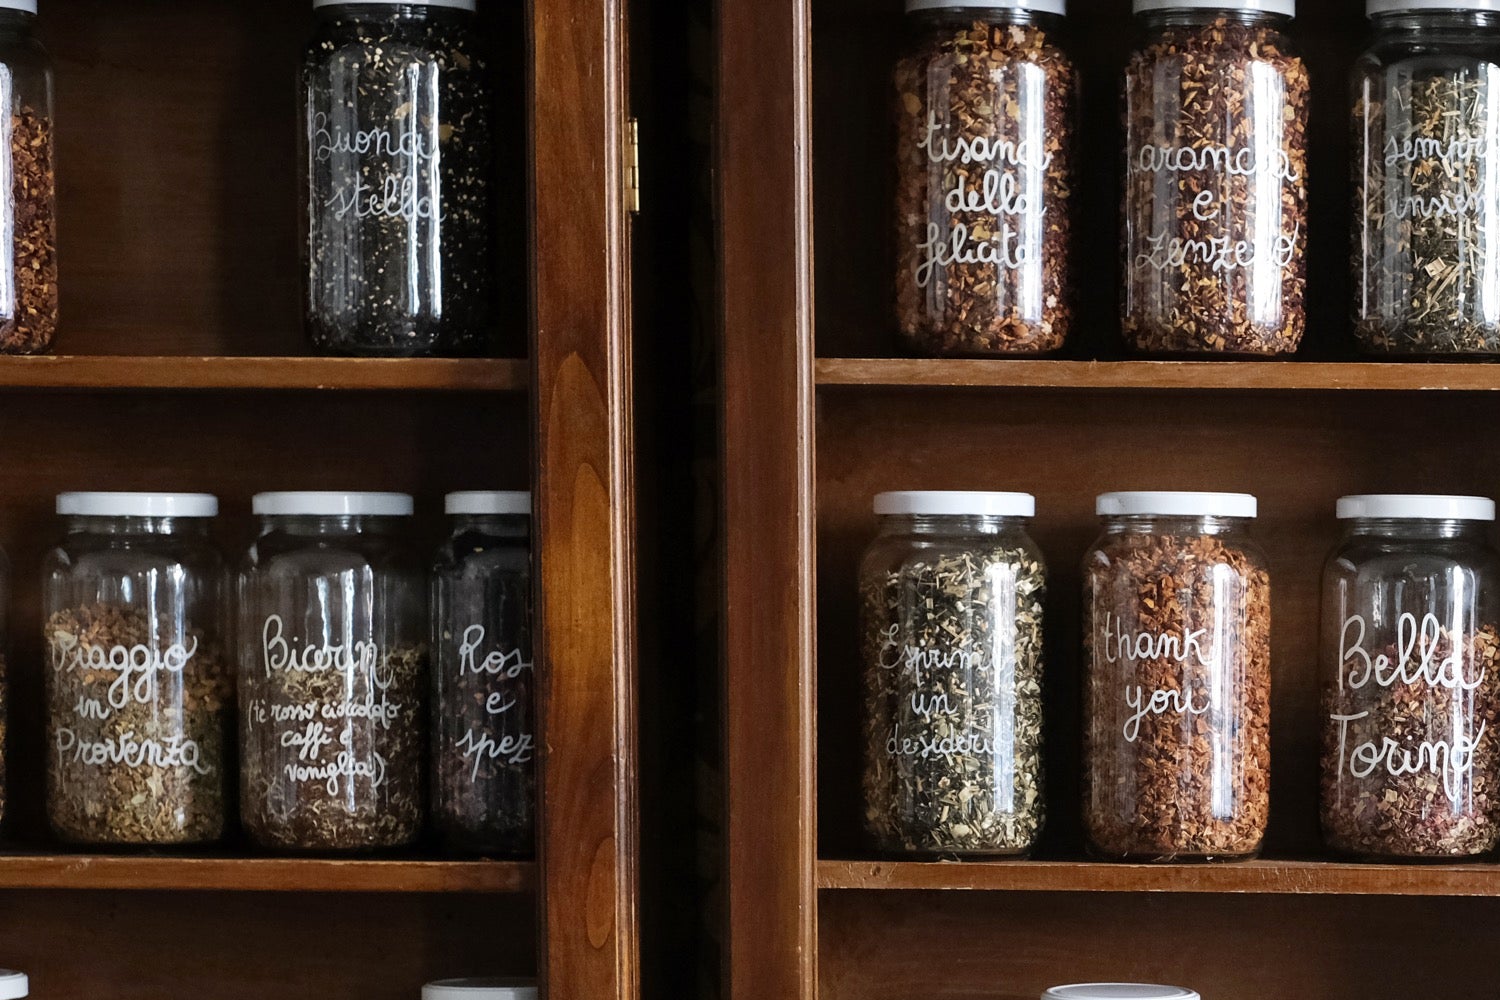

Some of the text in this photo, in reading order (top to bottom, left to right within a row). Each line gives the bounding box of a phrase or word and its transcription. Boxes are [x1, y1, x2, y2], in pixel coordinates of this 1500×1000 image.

[312, 111, 441, 162] Buona
[916, 110, 1053, 170] tisana
[1138, 144, 1298, 182] aranca
[325, 170, 446, 223] stella
[945, 169, 1047, 218] della
[1192, 189, 1220, 221] e
[1135, 223, 1299, 272] zenzeo
[458, 622, 535, 677] Ros
[879, 621, 1006, 689] Esprim
[1102, 611, 1218, 667] thank
[1337, 612, 1487, 695] Bella
[52, 629, 198, 709] Viaggio
[73, 694, 110, 721] in
[485, 690, 518, 715] e
[911, 690, 959, 724] un
[1122, 683, 1212, 743] you
[55, 727, 211, 775] Provenza
[455, 730, 535, 784] spez
[886, 721, 1010, 761] desideri
[1330, 709, 1487, 801] Torino
